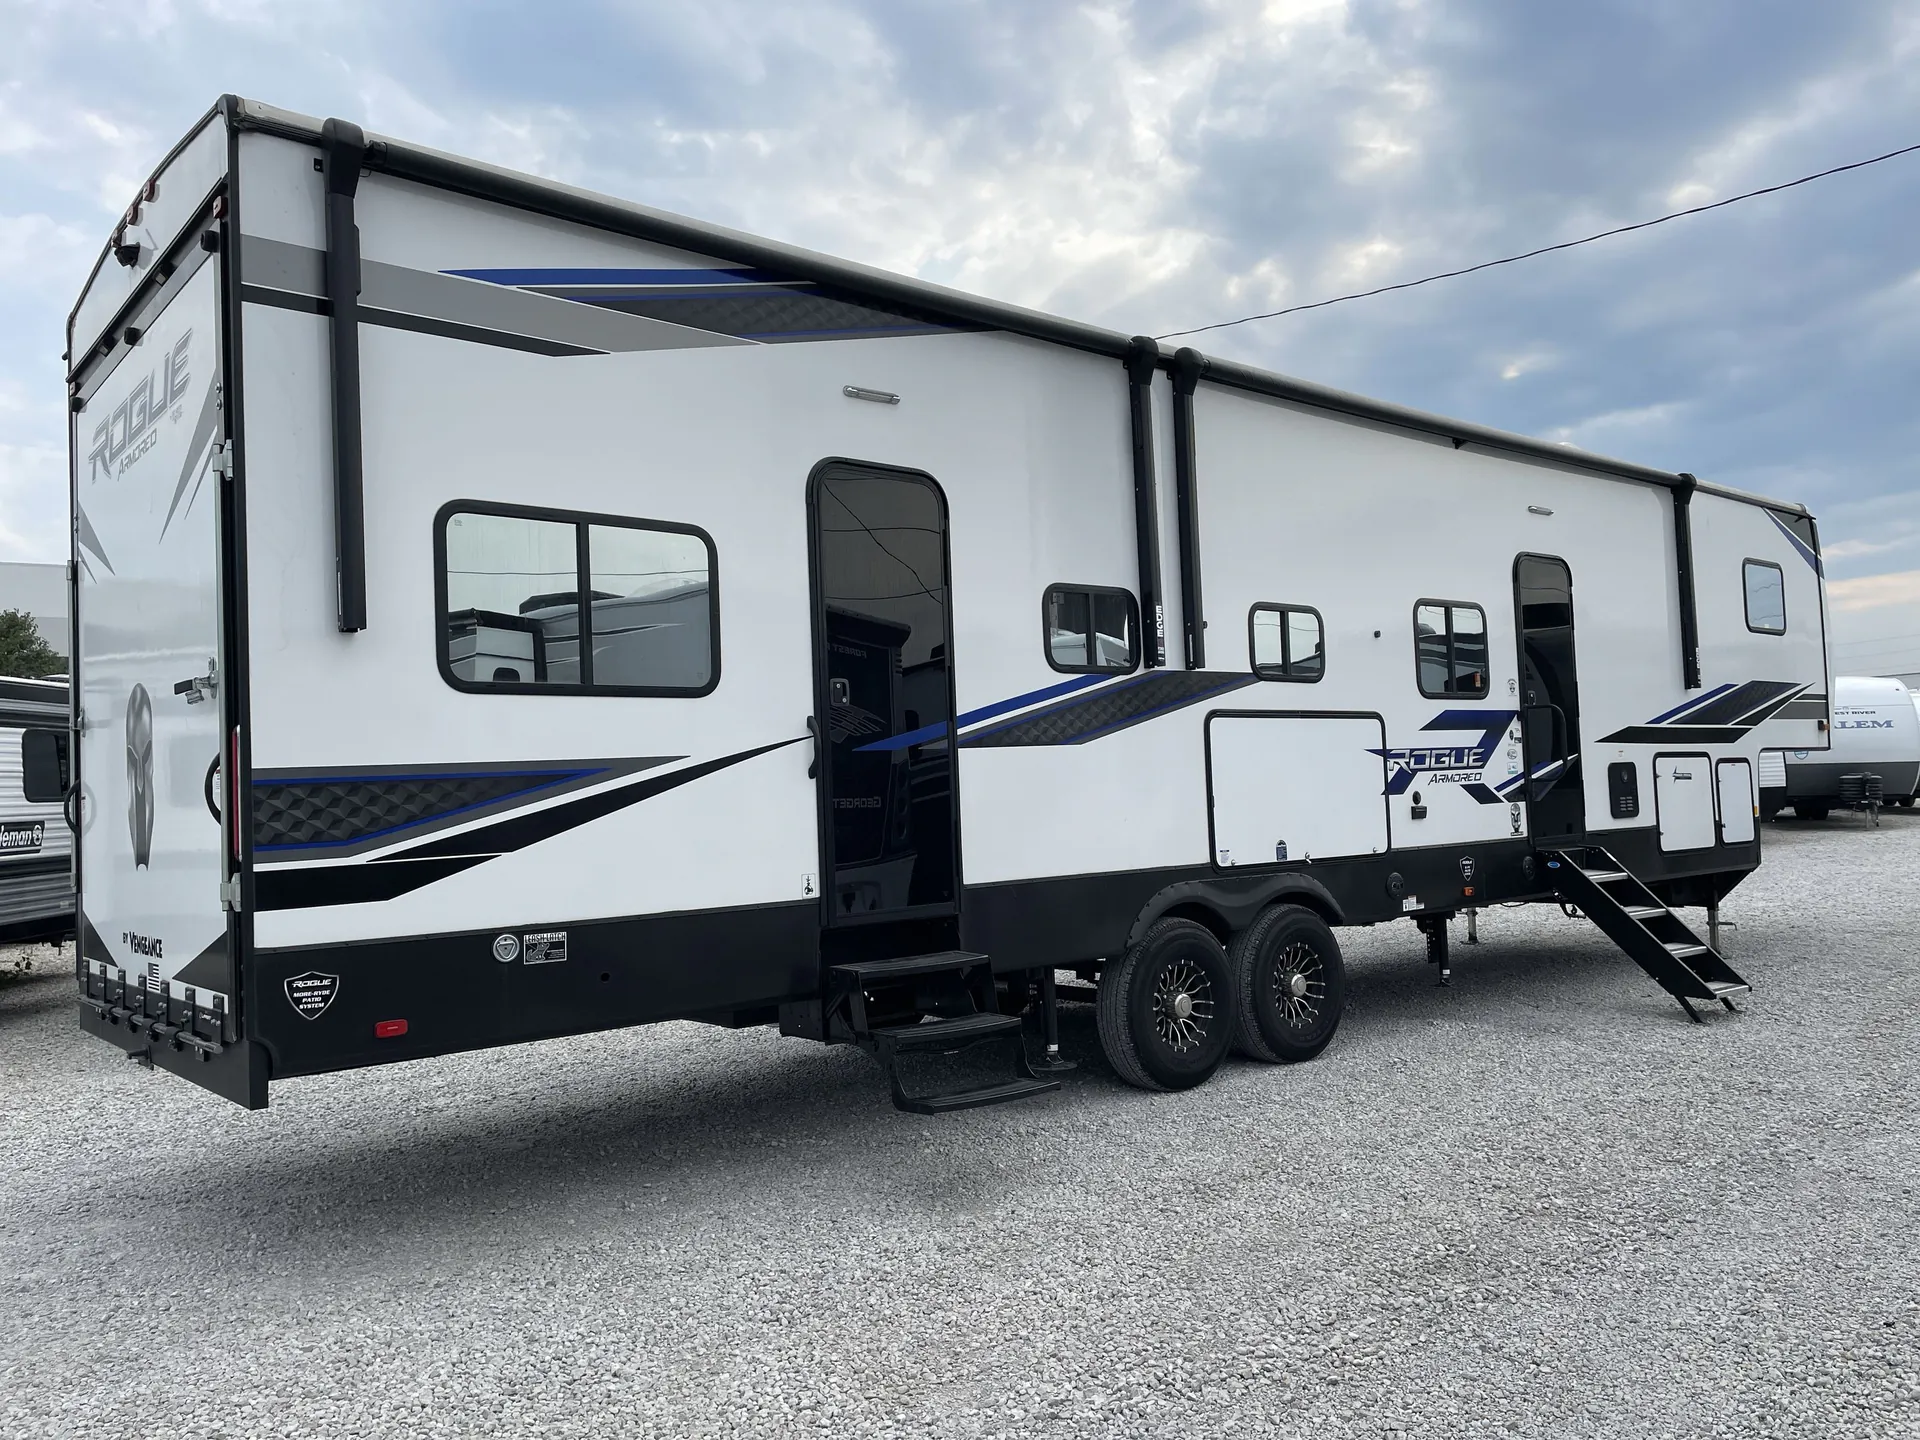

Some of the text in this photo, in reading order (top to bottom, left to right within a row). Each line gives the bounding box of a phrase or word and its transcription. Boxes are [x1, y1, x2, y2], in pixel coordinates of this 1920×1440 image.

[88, 328, 193, 485] ROGUE
[117, 428, 158, 481] ARMORED
[1155, 605, 1164, 637] EDGE
[1834, 720, 1894, 729] LEM
[1387, 748, 1485, 774] ROGUE
[1428, 772, 1482, 785] ARMORED
[122, 930, 163, 959] BY VENGEANCE
[292, 978, 333, 988] ROGUE
[299, 1002, 325, 1010] SYSTEM
